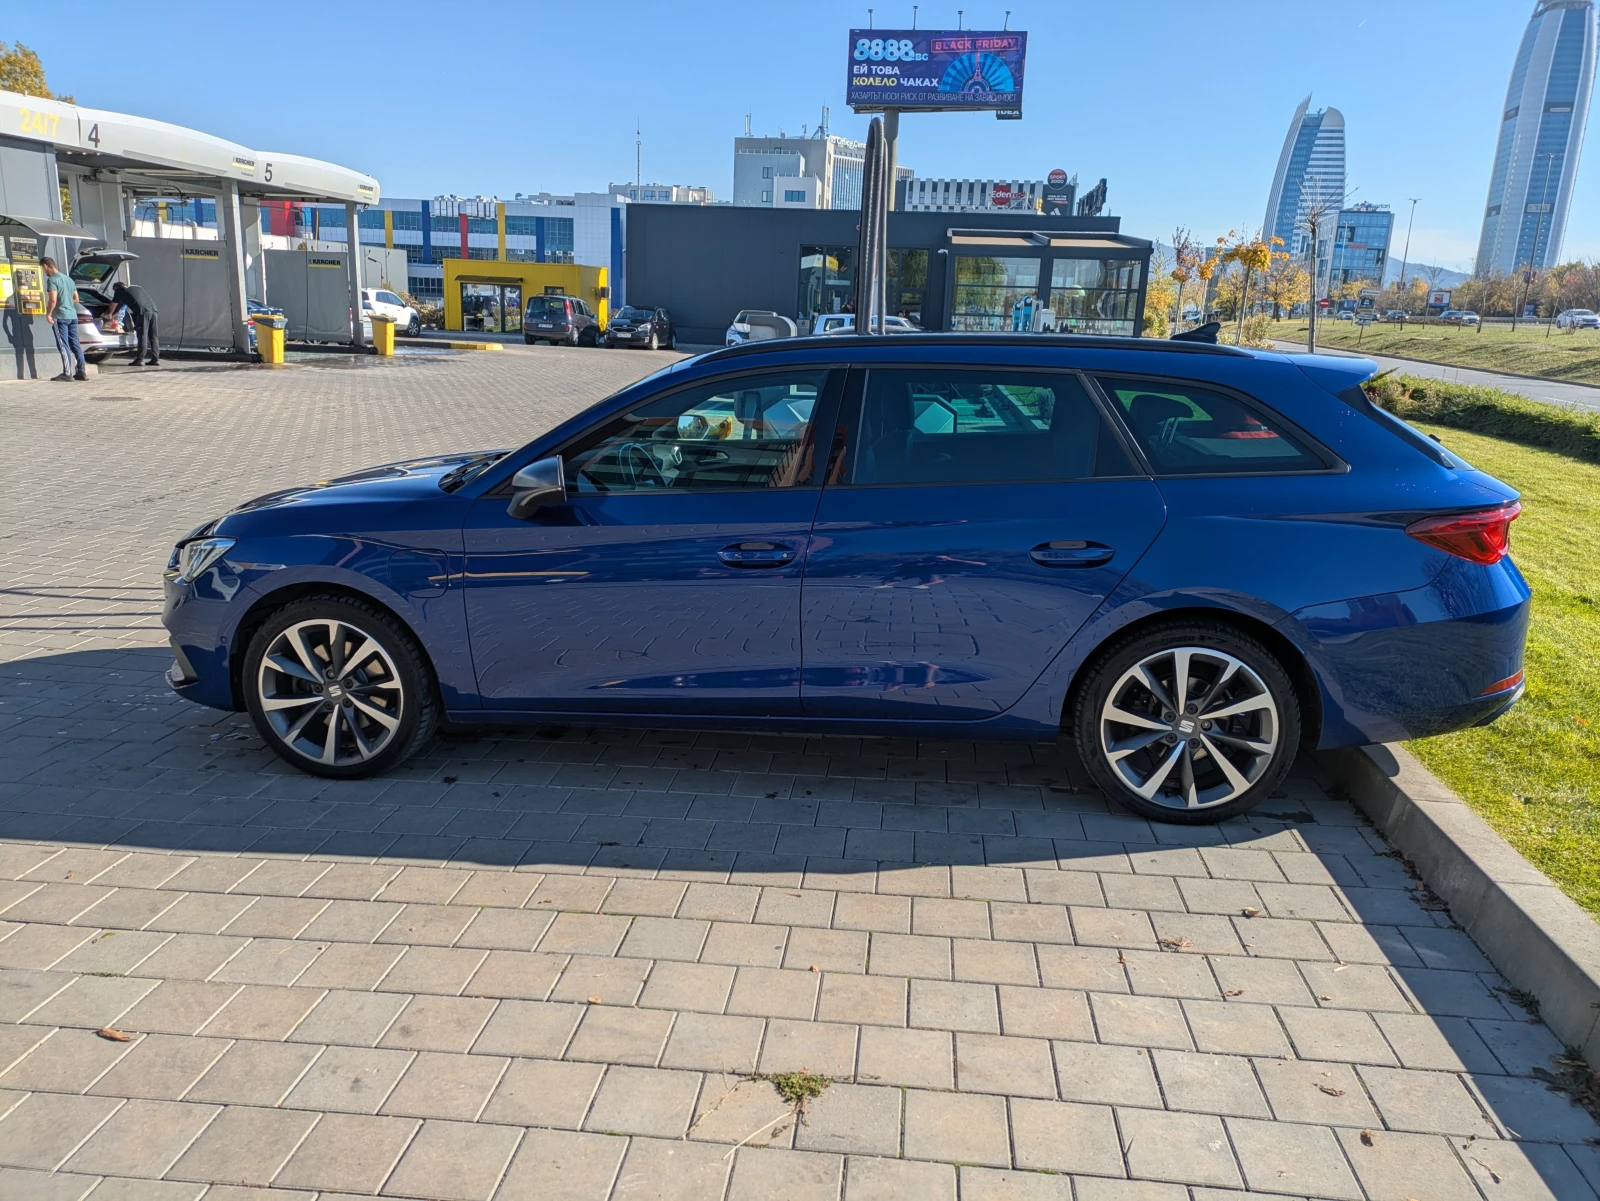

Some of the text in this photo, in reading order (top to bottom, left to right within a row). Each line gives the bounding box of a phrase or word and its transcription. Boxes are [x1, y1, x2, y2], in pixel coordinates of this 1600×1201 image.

[935, 38, 1016, 50] BLACK FRIDAY
[853, 63, 900, 75] ЕЙ ТОВА
[852, 76, 939, 87] КОЛЕЛО ЧАКАХ
[850, 91, 882, 100] ХАЗАРТЪТ
[882, 92, 900, 100] НОСИ
[900, 92, 918, 100] РИСК
[918, 92, 927, 100] ОТ
[927, 92, 964, 101] РАЗВИВАНЕ
[964, 93, 974, 101] НА
[19, 108, 60, 137] 24/7
[87, 123, 101, 148] 4
[264, 162, 273, 183] 5
